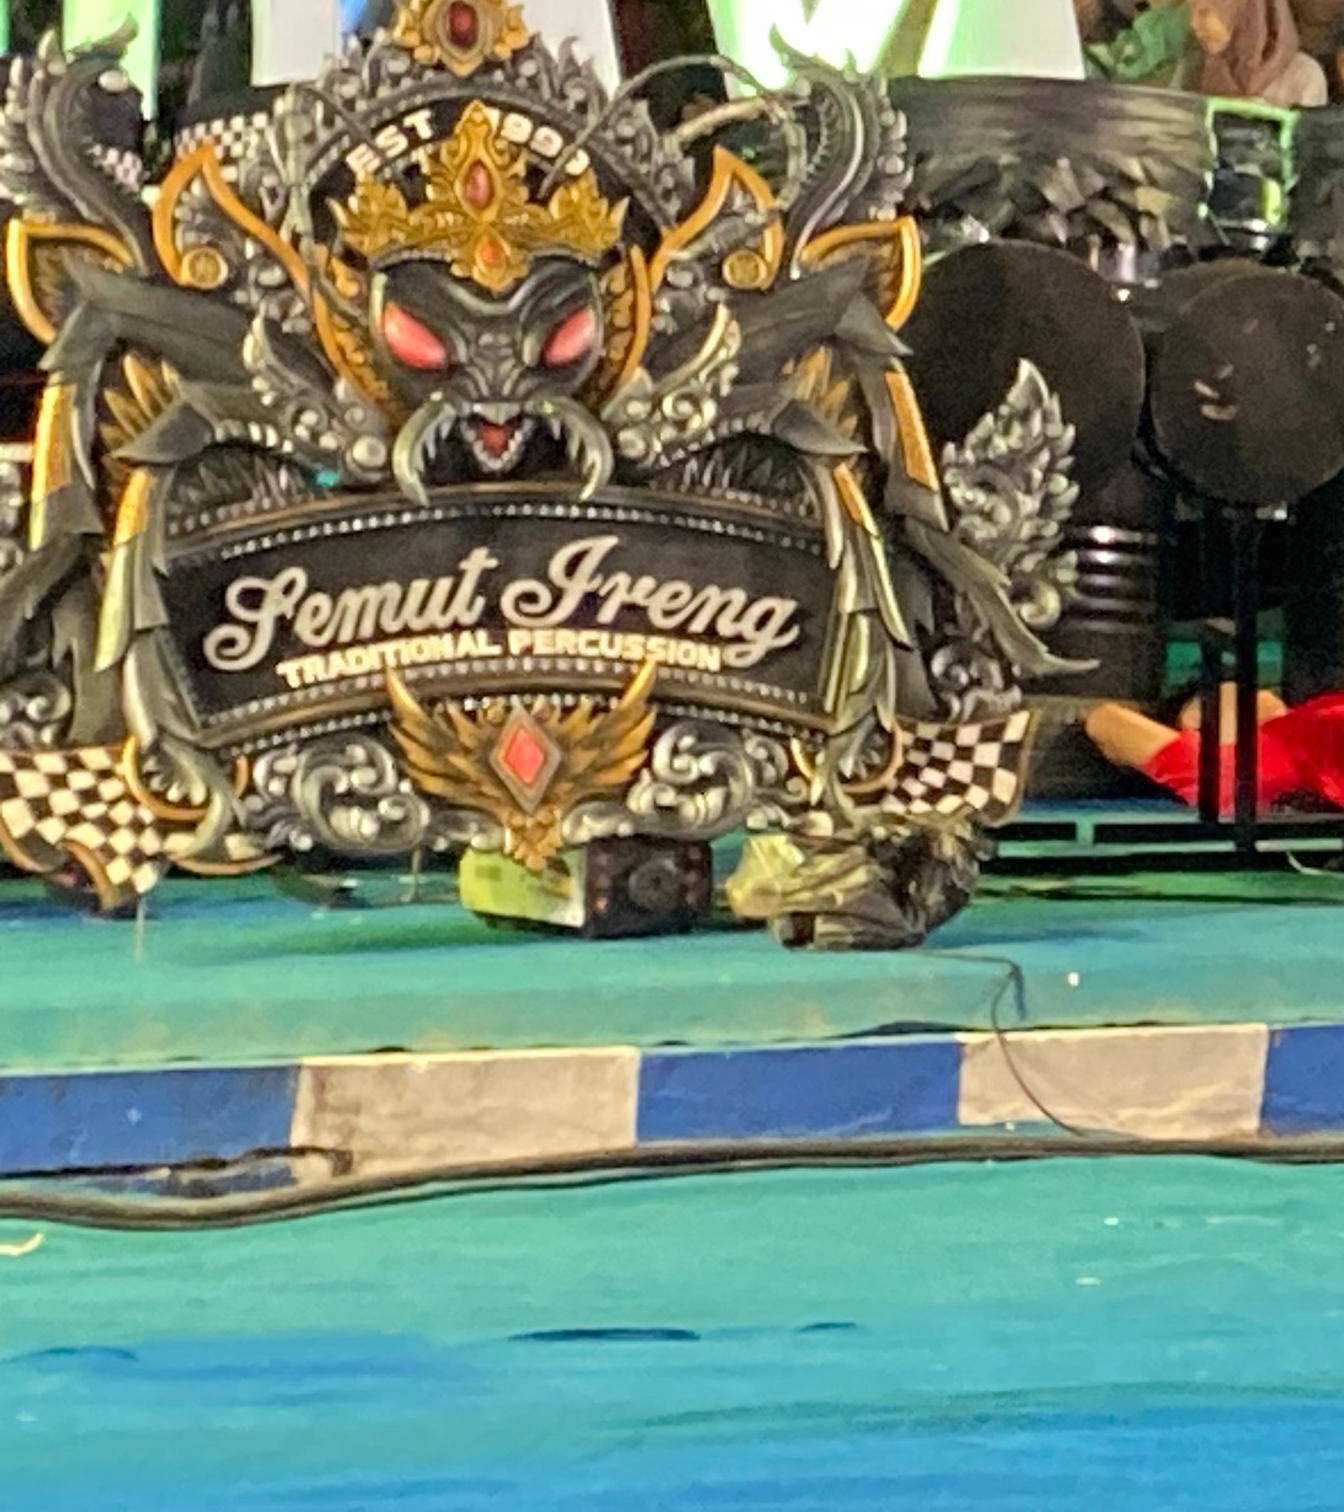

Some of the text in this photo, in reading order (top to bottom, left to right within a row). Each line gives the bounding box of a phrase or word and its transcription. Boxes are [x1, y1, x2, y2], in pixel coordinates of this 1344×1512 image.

[345, 109, 433, 180] EST
[202, 535, 800, 671] Semut Ireng
[275, 627, 722, 688] TRADITIONAL PERCUSSION
